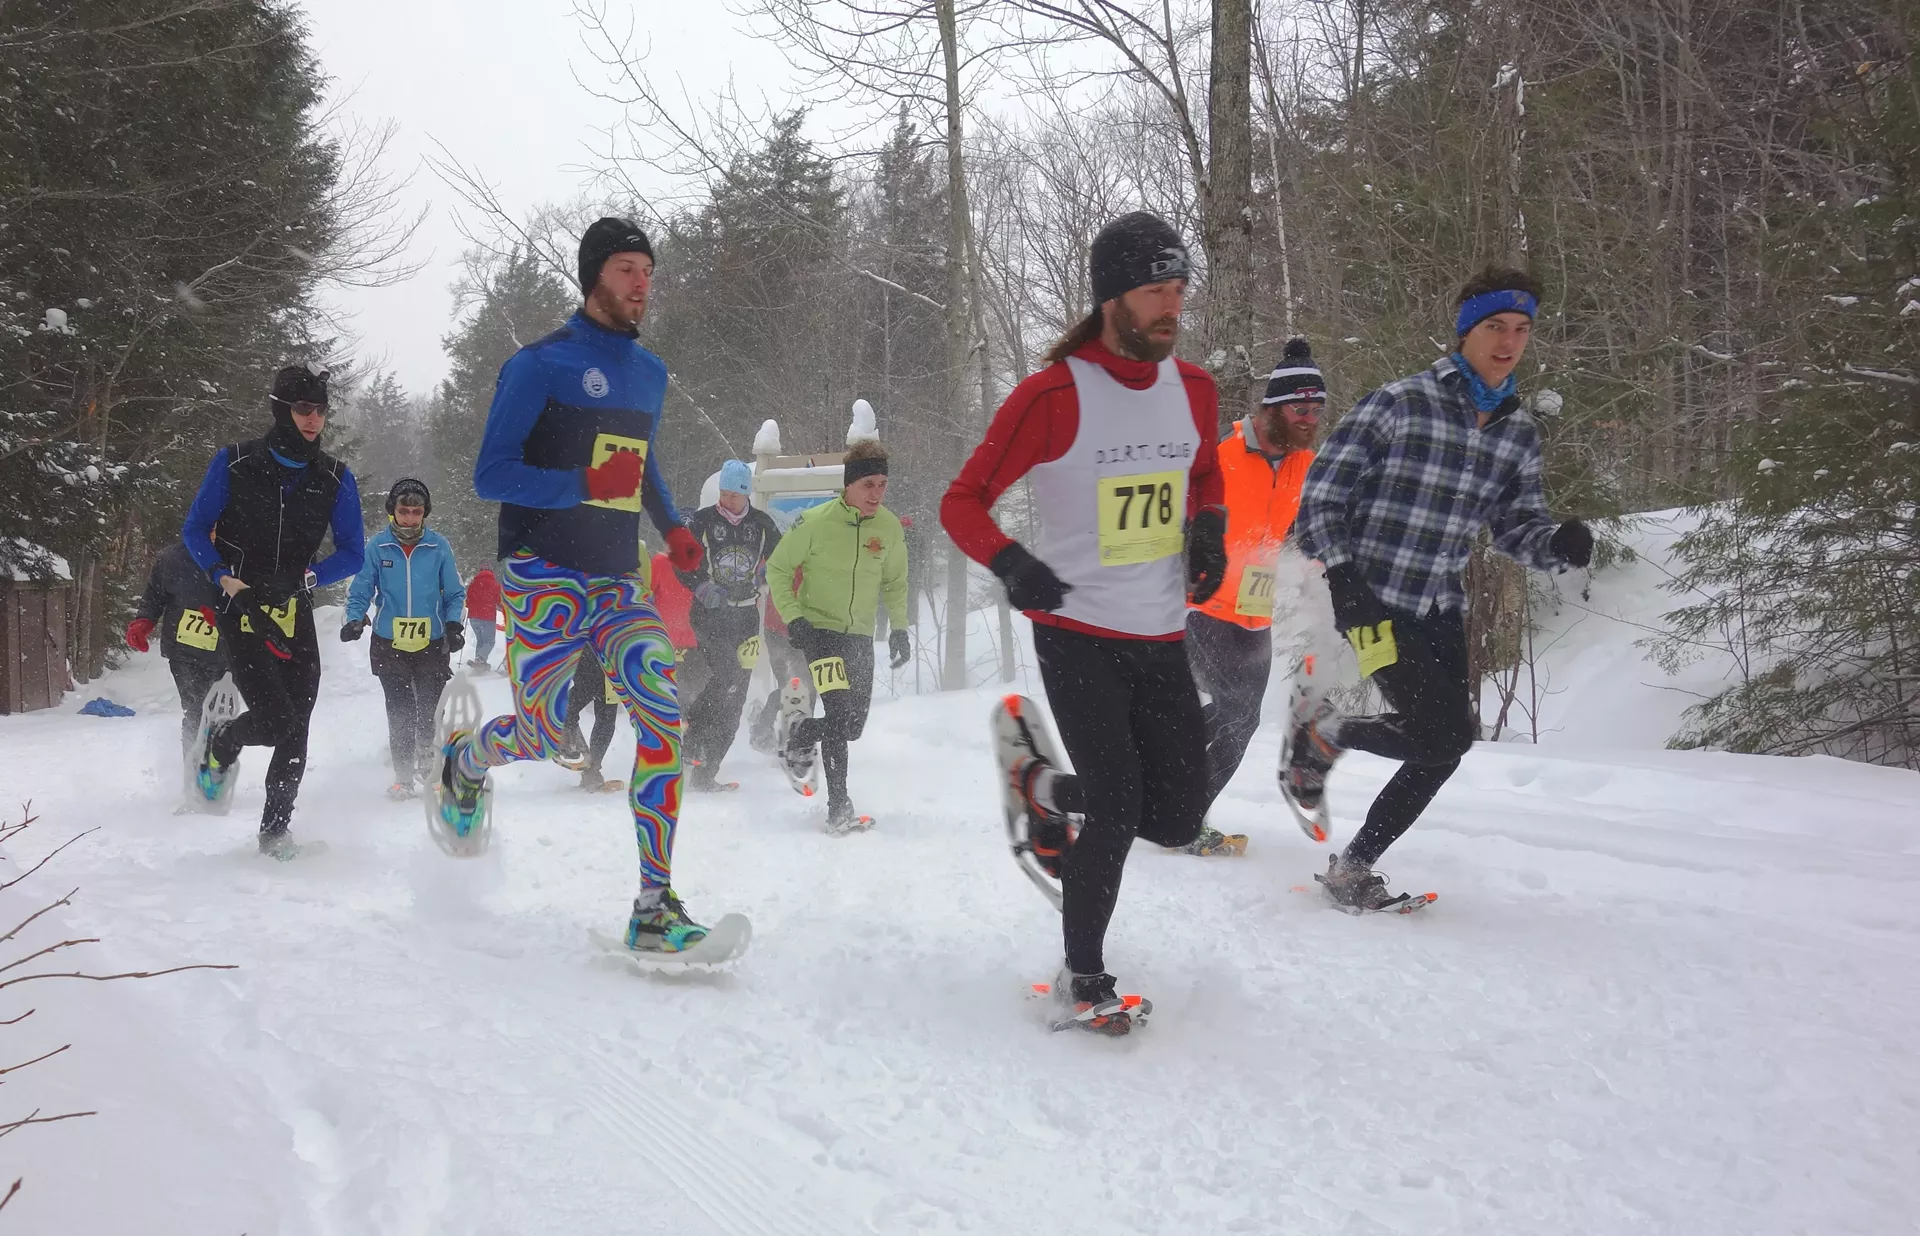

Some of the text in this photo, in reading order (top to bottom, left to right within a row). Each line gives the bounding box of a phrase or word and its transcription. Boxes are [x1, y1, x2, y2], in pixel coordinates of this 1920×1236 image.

[1114, 482, 1172, 530] 778
[399, 622, 426, 639] 774
[814, 661, 846, 687] 770
